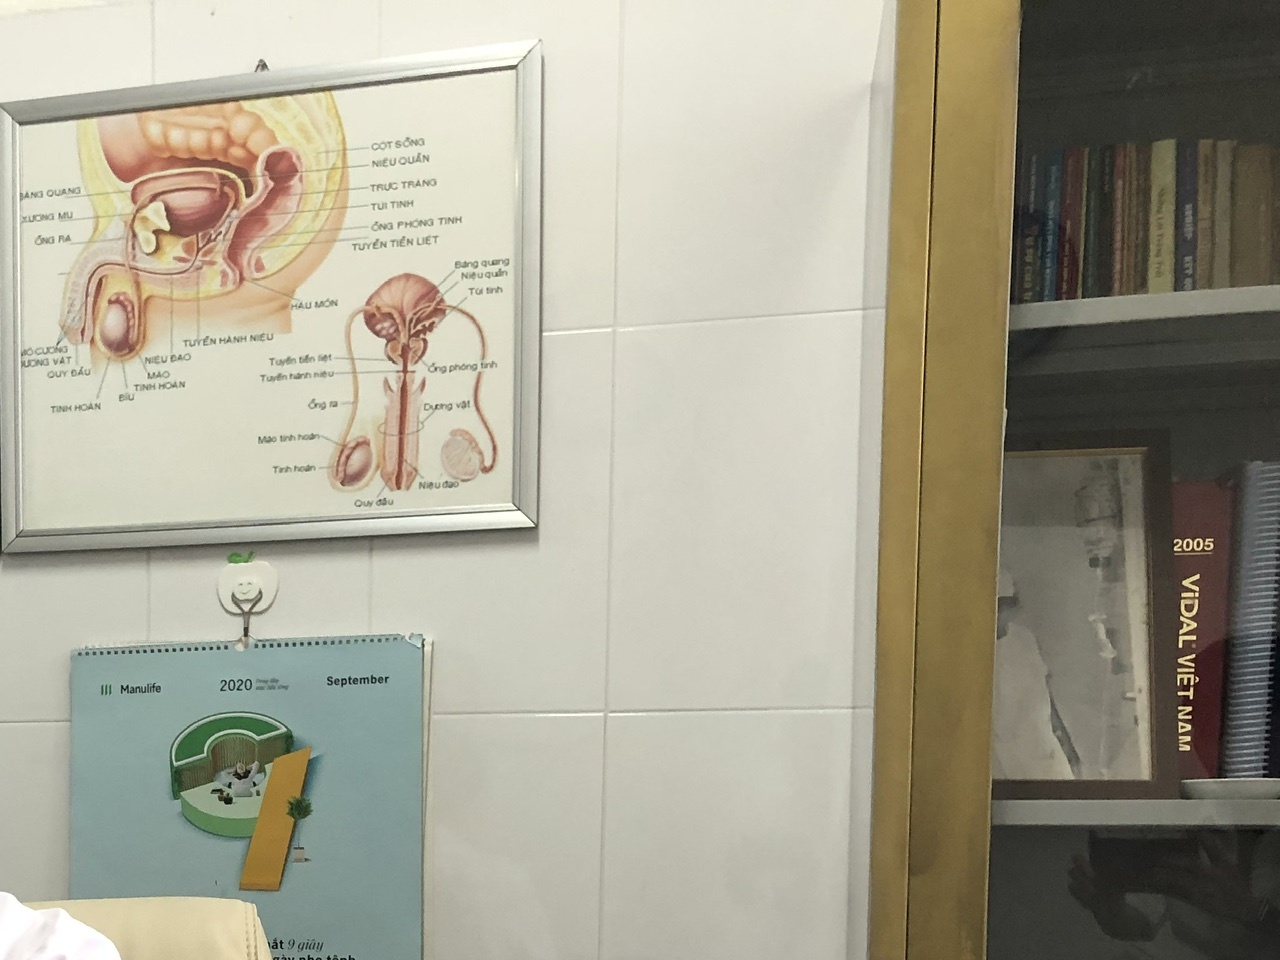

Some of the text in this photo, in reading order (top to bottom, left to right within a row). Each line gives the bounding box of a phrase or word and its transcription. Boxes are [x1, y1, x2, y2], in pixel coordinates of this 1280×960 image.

[46, 186, 82, 198] QUANG
[1173, 537, 1215, 552] 2005
[120, 682, 162, 695] Manulife
[220, 678, 253, 692] 2020
[326, 674, 390, 688] September
[1177, 705, 1193, 752] NAM
[287, 938, 296, 950] 9
[297, 938, 324, 953] giây
